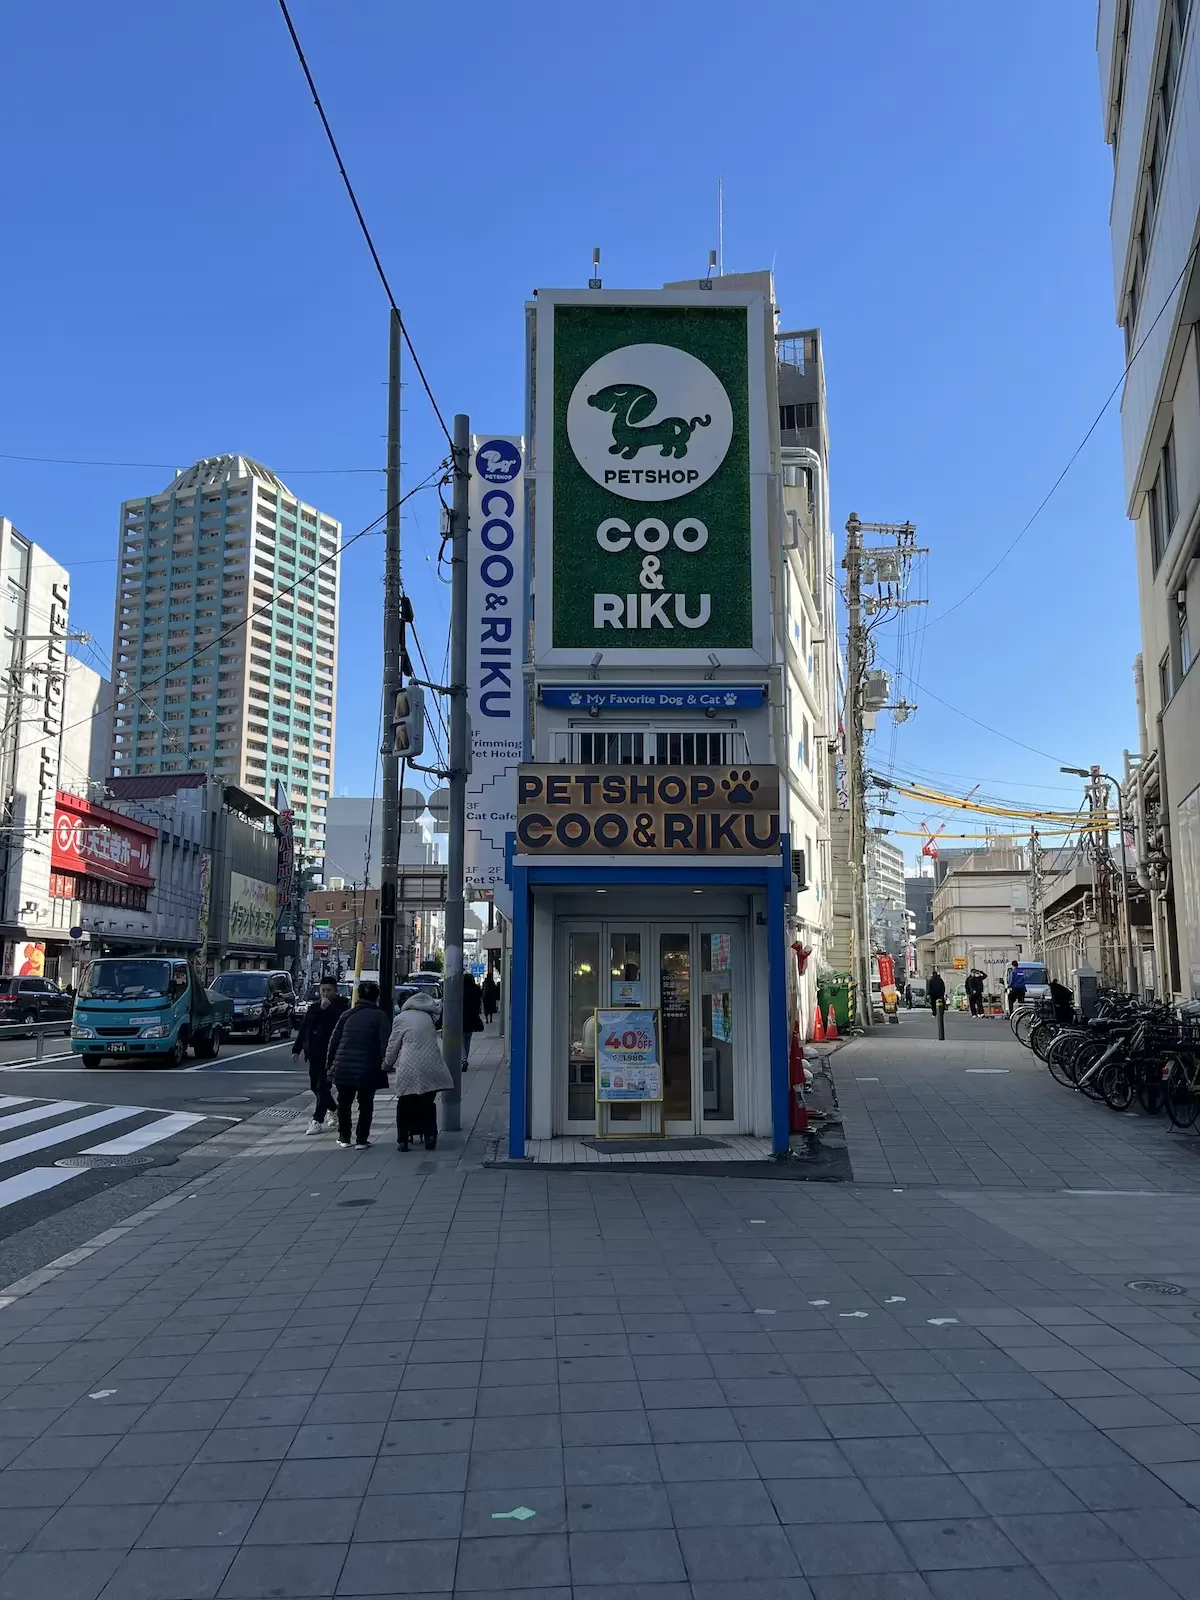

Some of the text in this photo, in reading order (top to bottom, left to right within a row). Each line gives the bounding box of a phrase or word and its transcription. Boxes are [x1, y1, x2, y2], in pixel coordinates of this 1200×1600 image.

[604, 469, 699, 484] PETSHOP
[596, 517, 709, 553] COO
[639, 554, 665, 590] &
[593, 593, 711, 629] RIKU
[585, 693, 721, 706] My Favorite Dog & Cat
[490, 750, 522, 758] Hotel
[518, 775, 716, 805] PETSHOP
[466, 802, 480, 810] 3F
[466, 812, 518, 820] Cat Cafe
[87, 824, 150, 870] 天王寺ホール
[465, 876, 485, 884] Pet
